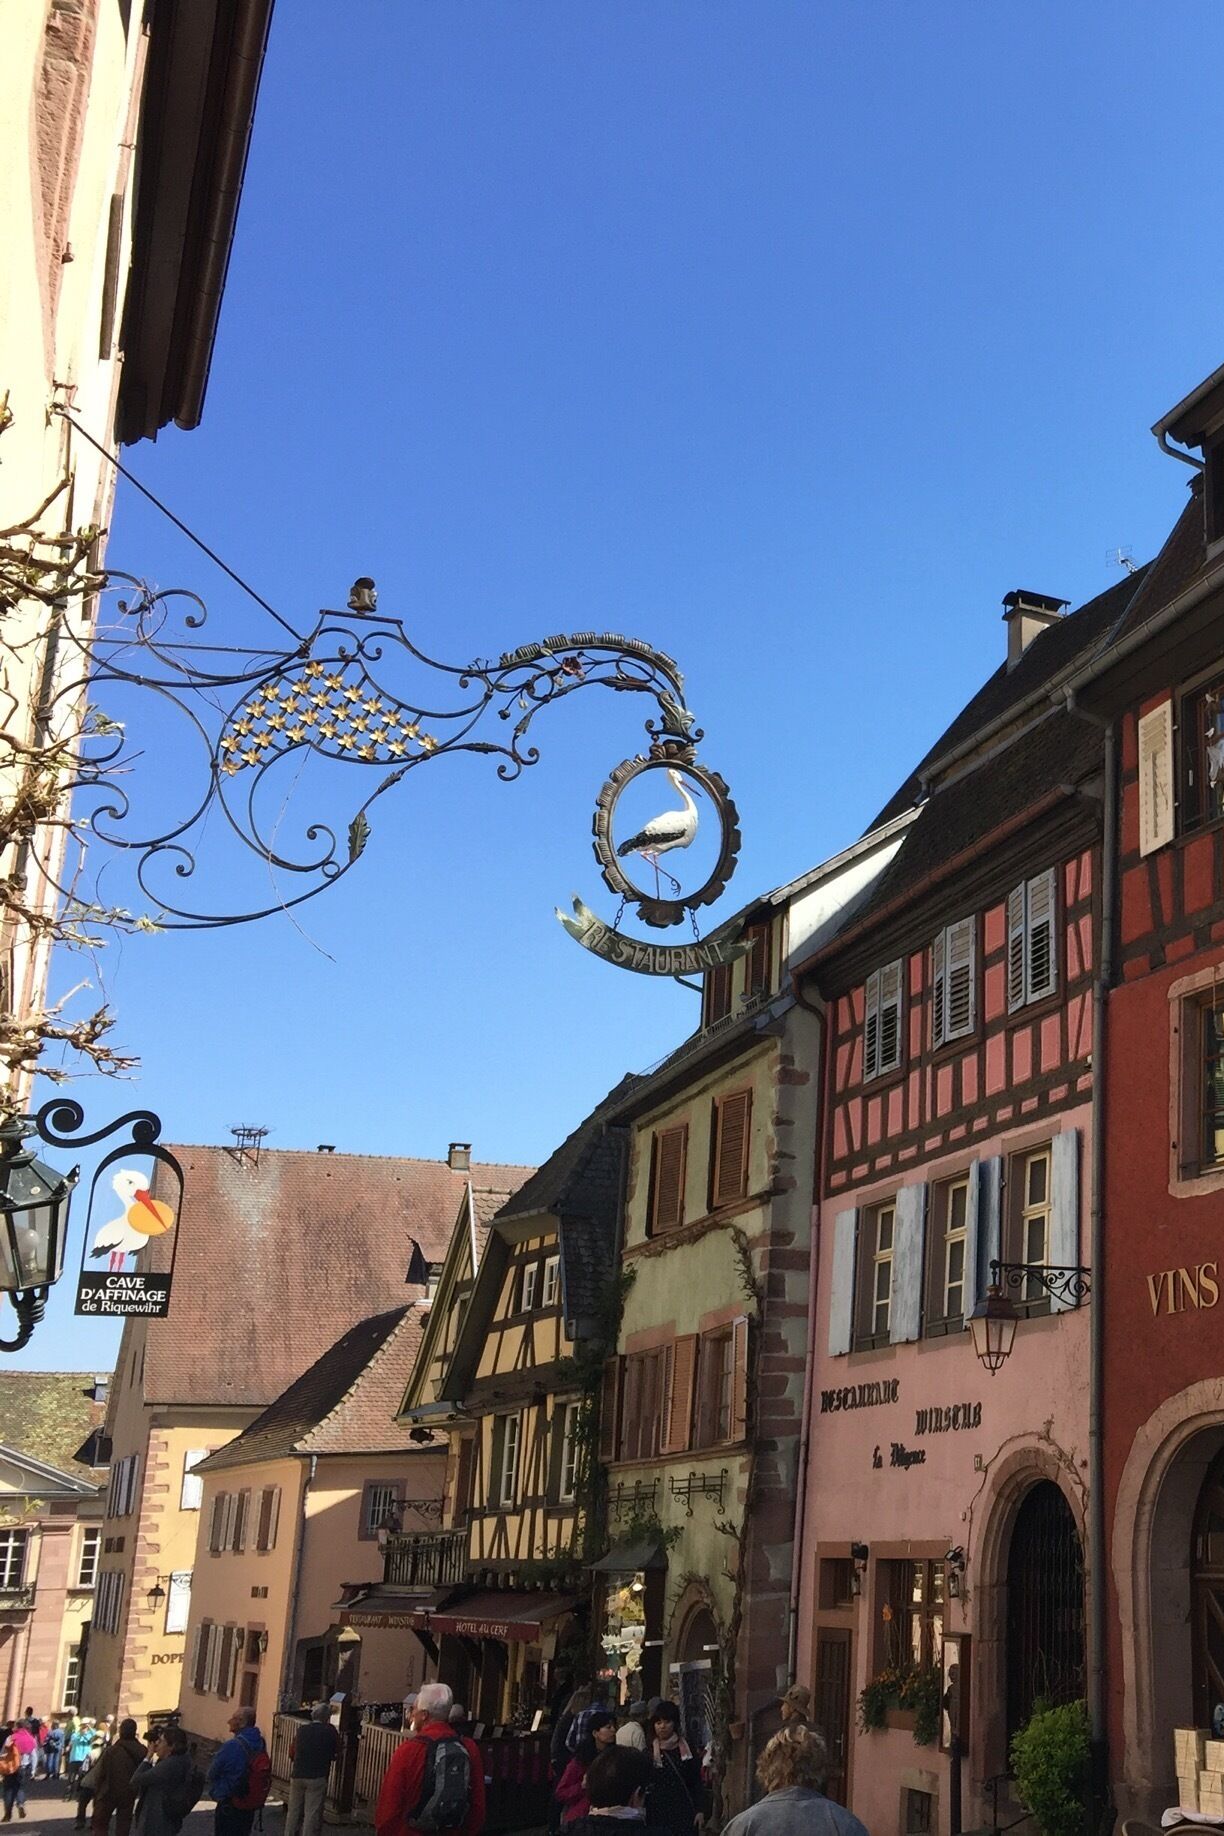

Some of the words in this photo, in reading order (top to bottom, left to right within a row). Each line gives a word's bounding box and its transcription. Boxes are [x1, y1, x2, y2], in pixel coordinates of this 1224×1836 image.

[579, 921, 725, 974] RESTAURANT
[105, 1276, 146, 1289] CAVE
[1145, 1261, 1221, 1318] VINS
[80, 1288, 167, 1302] D'AFFINAGE
[81, 1299, 98, 1312] de
[100, 1300, 162, 1315] Riquewihr
[914, 1401, 983, 1436] WINSTUB
[479, 1623, 490, 1634] AU
[490, 1624, 509, 1637] CERF
